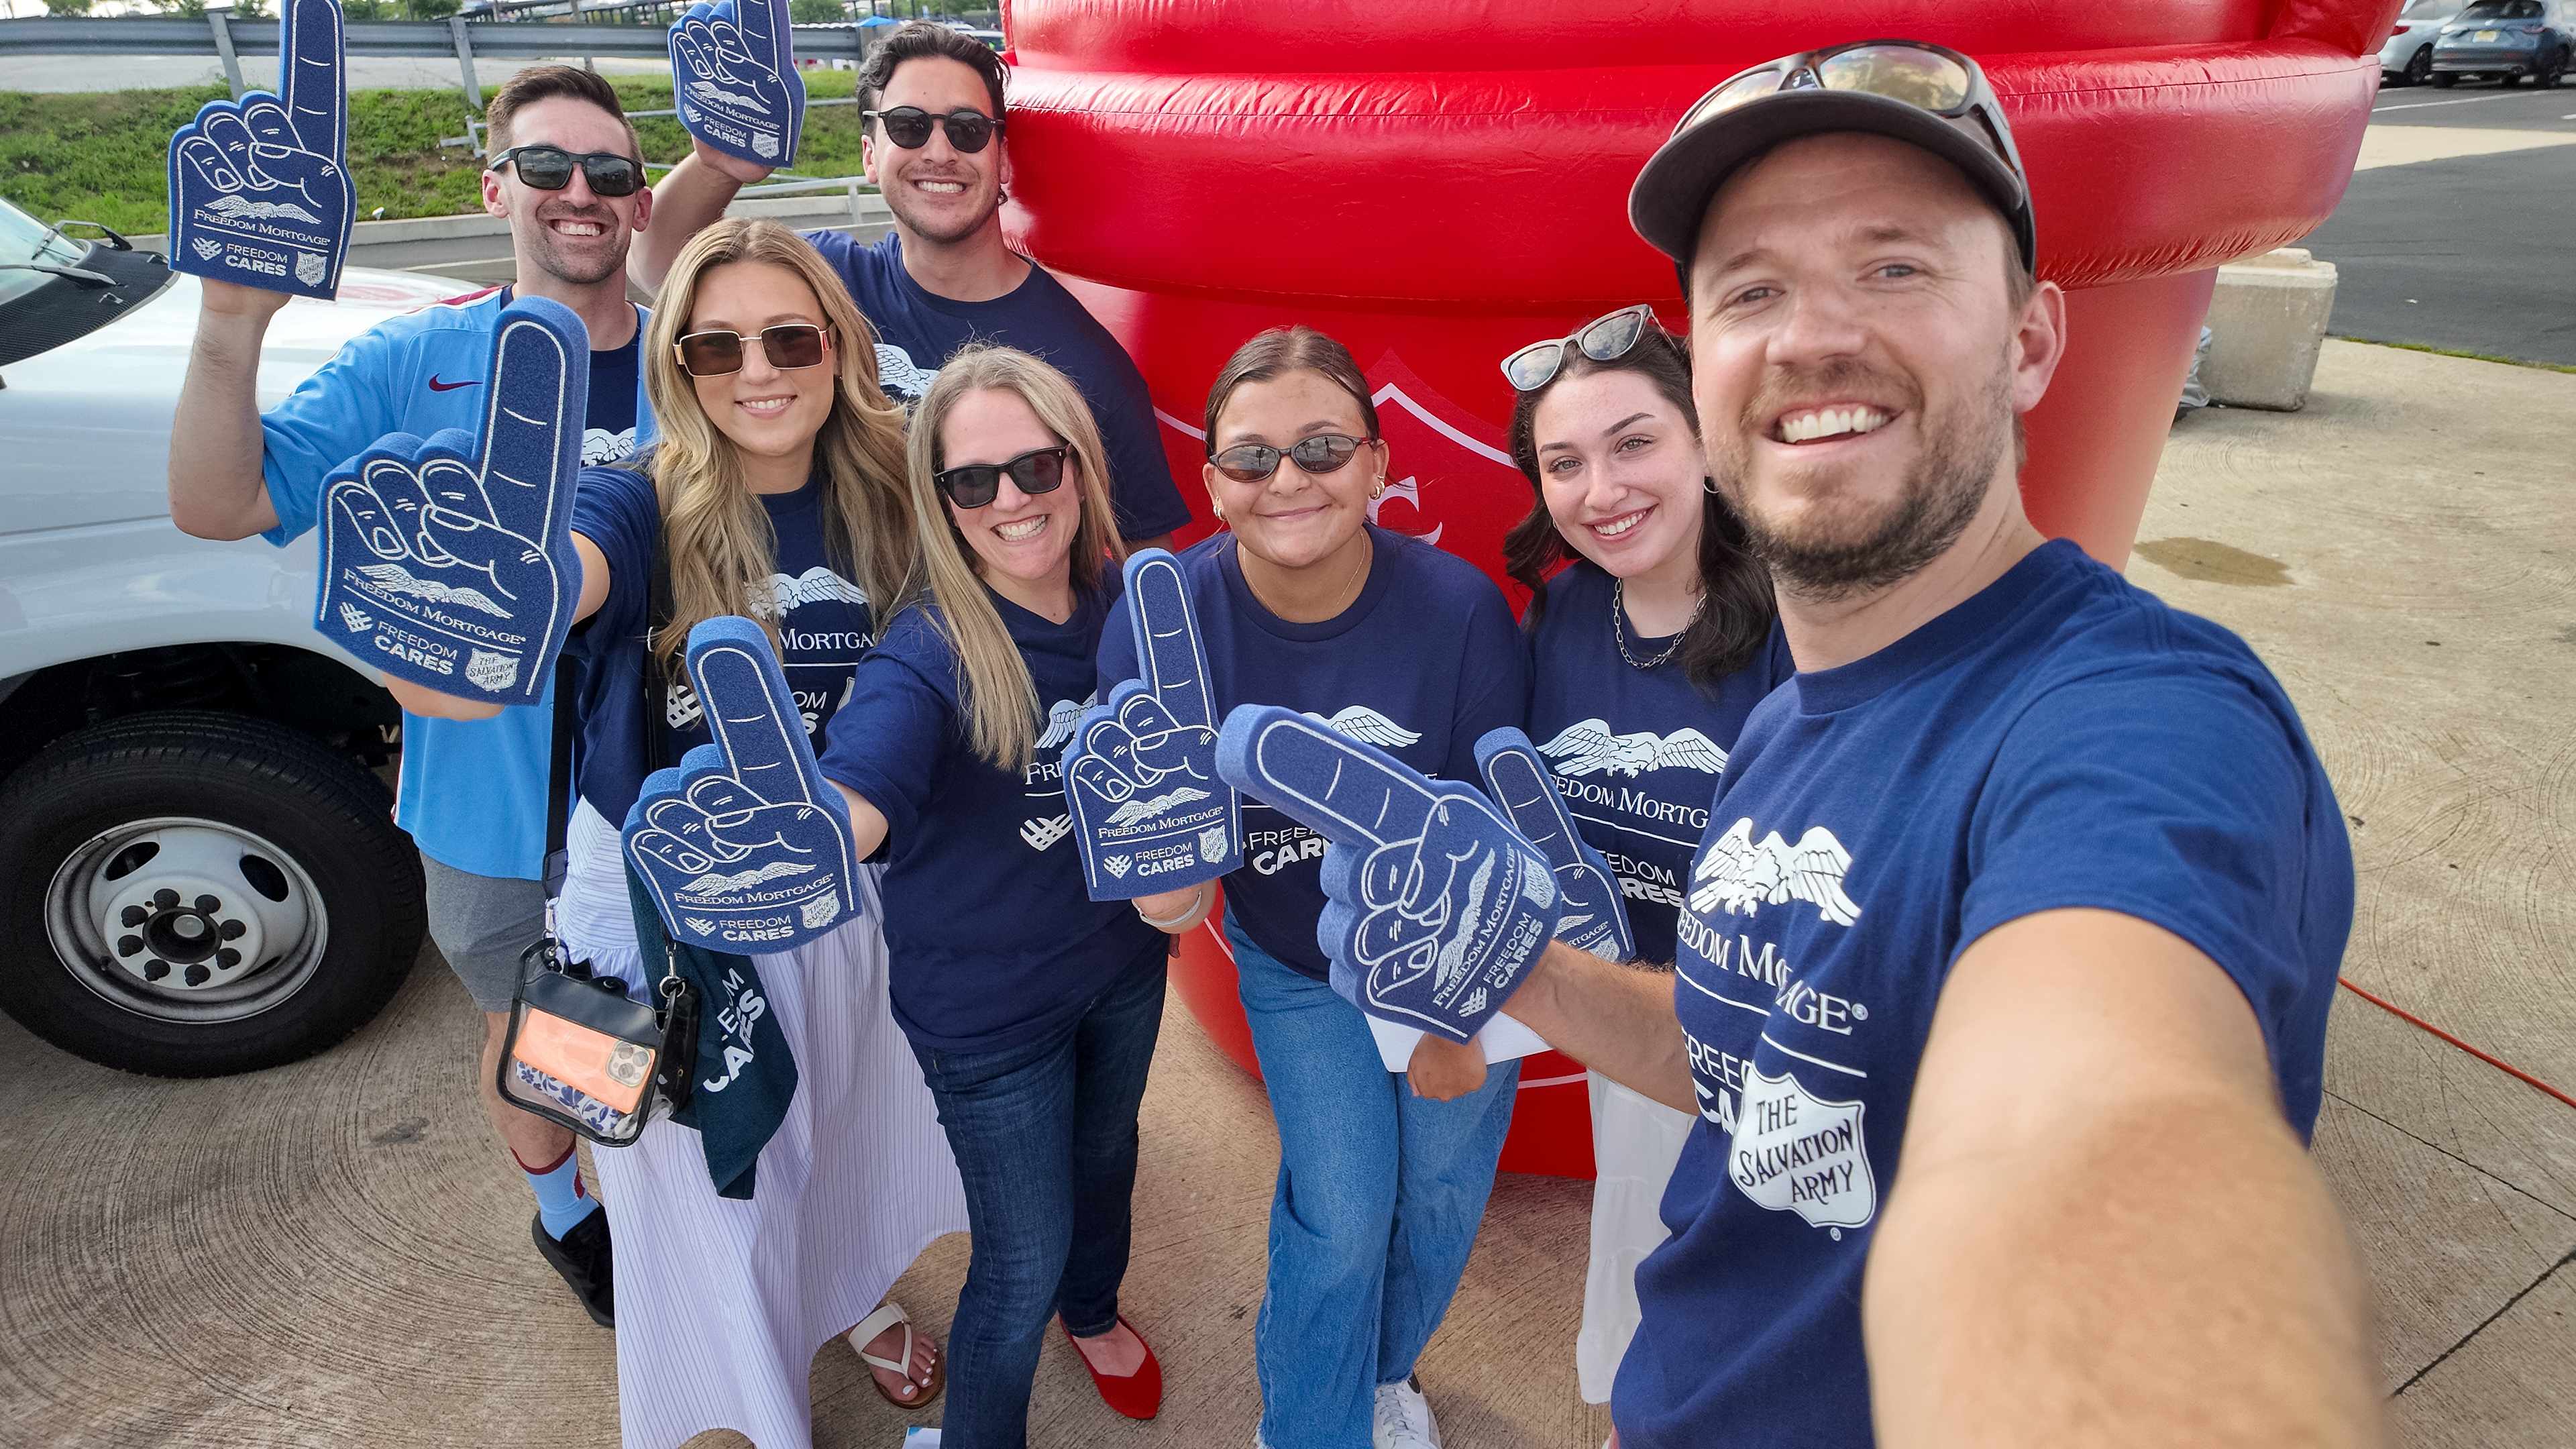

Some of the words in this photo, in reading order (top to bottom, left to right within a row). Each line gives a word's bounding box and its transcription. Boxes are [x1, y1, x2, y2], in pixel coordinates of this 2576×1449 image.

[704, 115, 747, 139] FREEDOM
[704, 124, 746, 148] CARES
[193, 209, 256, 231] FREEDOM
[225, 244, 288, 264] FREEDOM
[225, 255, 287, 276] CARES
[343, 568, 419, 614] FREEDOM
[377, 621, 458, 660] FREEDOM
[778, 628, 876, 651] MORTGA
[374, 635, 453, 676] CARES
[1550, 774, 1615, 808] EDOM
[1617, 787, 1709, 828] MORTG
[1097, 822, 1157, 839] FREEDOM
[1248, 827, 1320, 851] FREE
[1135, 842, 1193, 862] FREEDOM
[1137, 853, 1195, 877] CARES
[1252, 837, 1331, 875] CAR
[1596, 849, 1676, 886] EDOM
[674, 892, 743, 904] FREEDOM
[1617, 877, 1685, 908] RES
[718, 914, 792, 930] FREEDOM
[722, 926, 795, 941] CARES
[1677, 904, 1733, 971] EEDOM
[1483, 912, 1532, 983] FREEDOM
[1494, 918, 1544, 989] CARES
[1433, 941, 1486, 1006] FREEDOM
[1756, 1094, 1798, 1135] THE
[1739, 1118, 1854, 1187] SALVATION
[1791, 1161, 1854, 1205] ARMY
